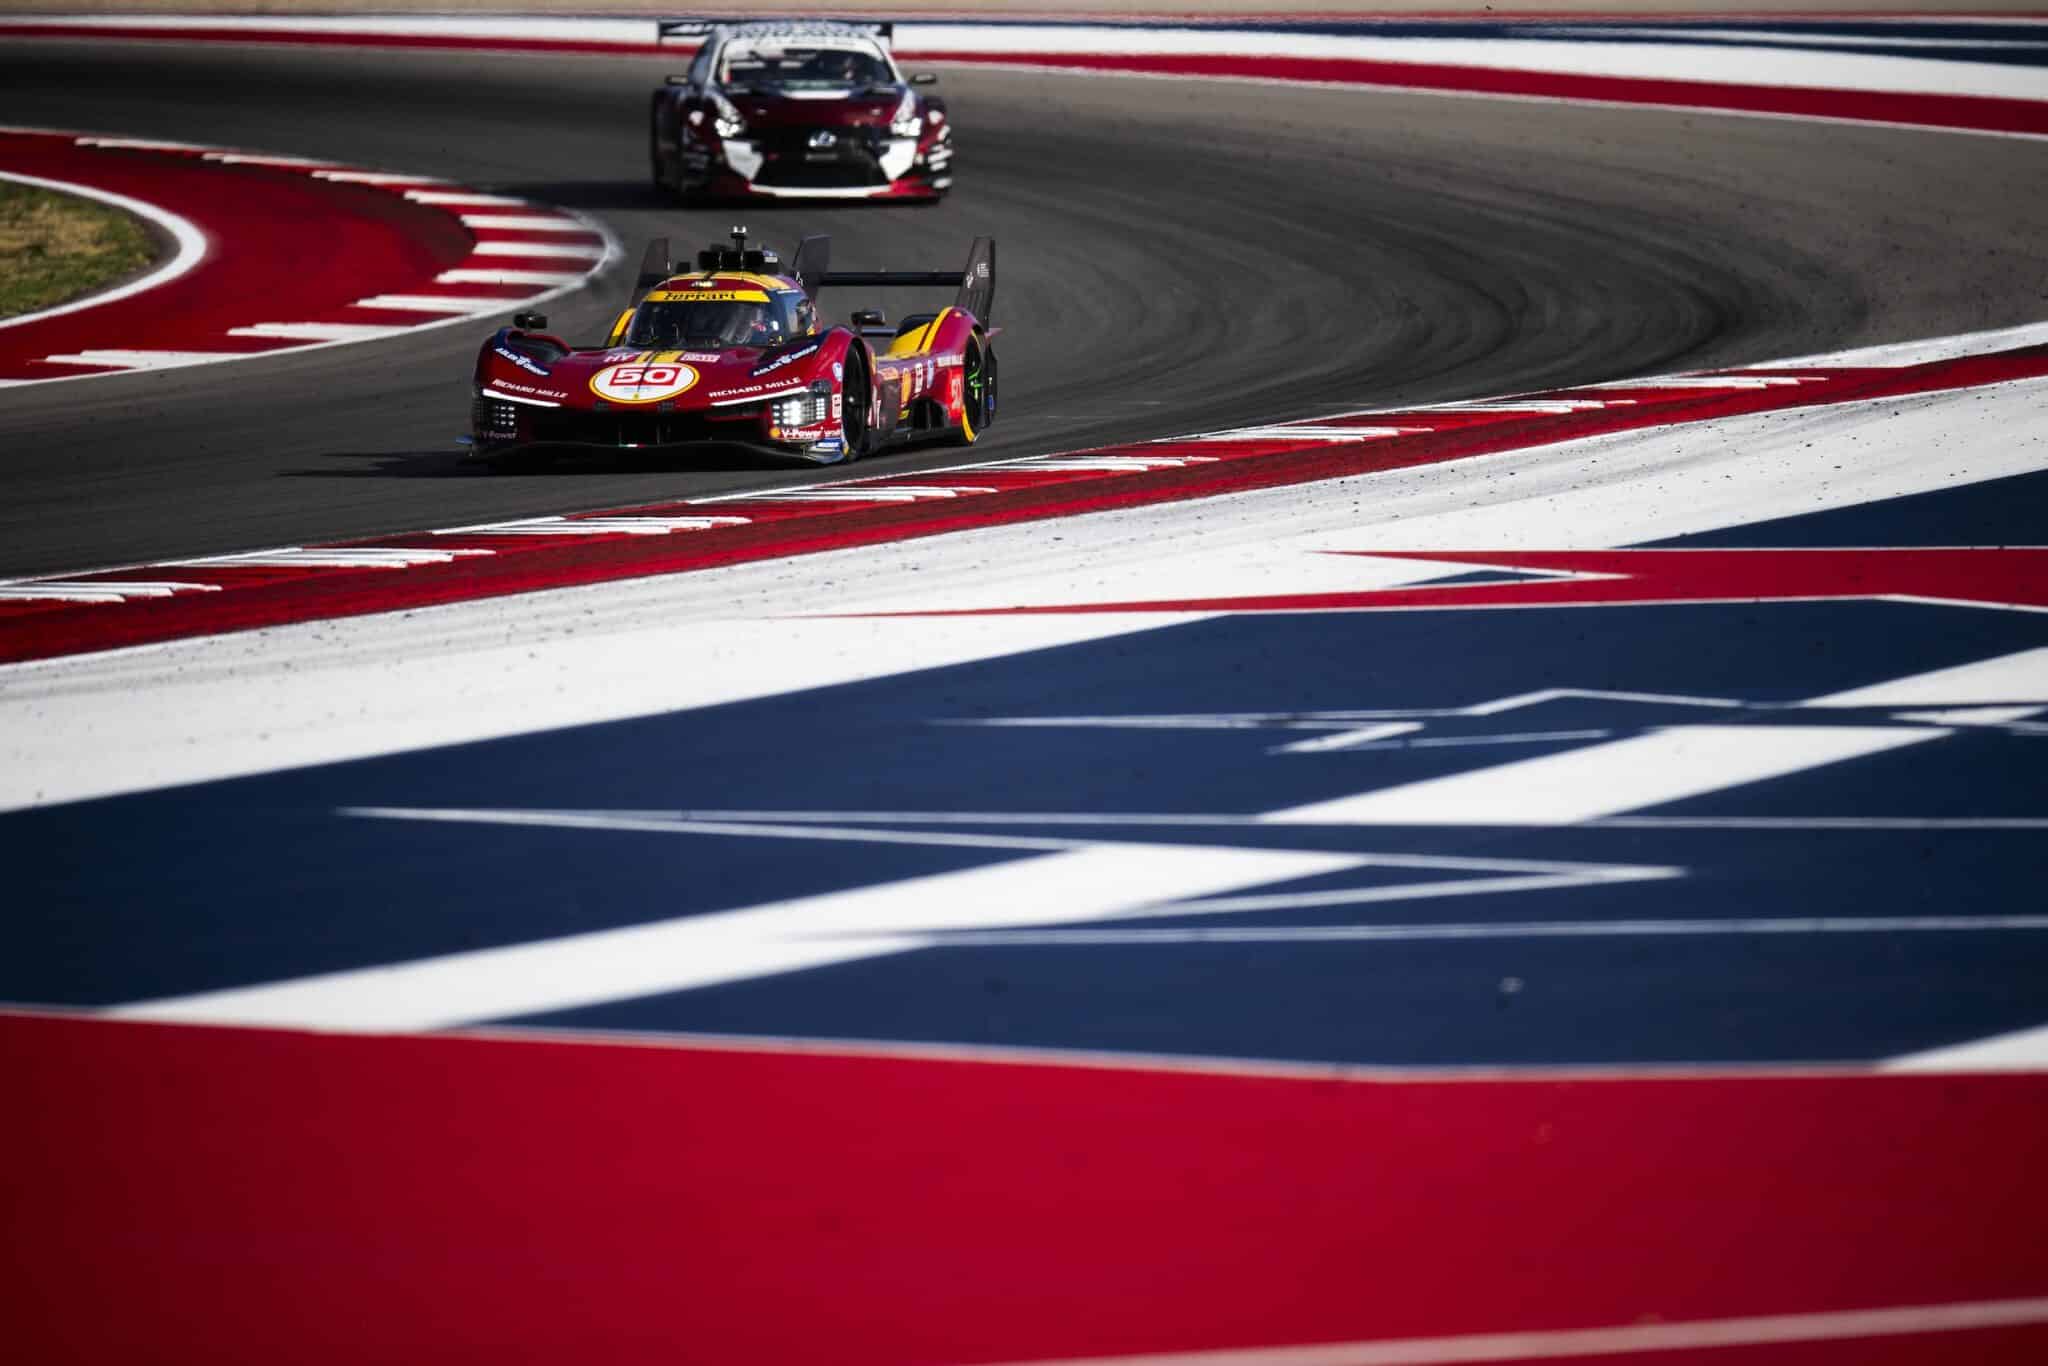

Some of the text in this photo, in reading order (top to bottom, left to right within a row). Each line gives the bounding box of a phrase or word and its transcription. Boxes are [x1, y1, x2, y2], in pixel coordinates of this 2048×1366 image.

[664, 291, 736, 301] Ferrari
[610, 367, 680, 386] 50
[491, 379, 568, 399] RICHARD MILLE
[708, 377, 801, 398] RICHARD MILLE
